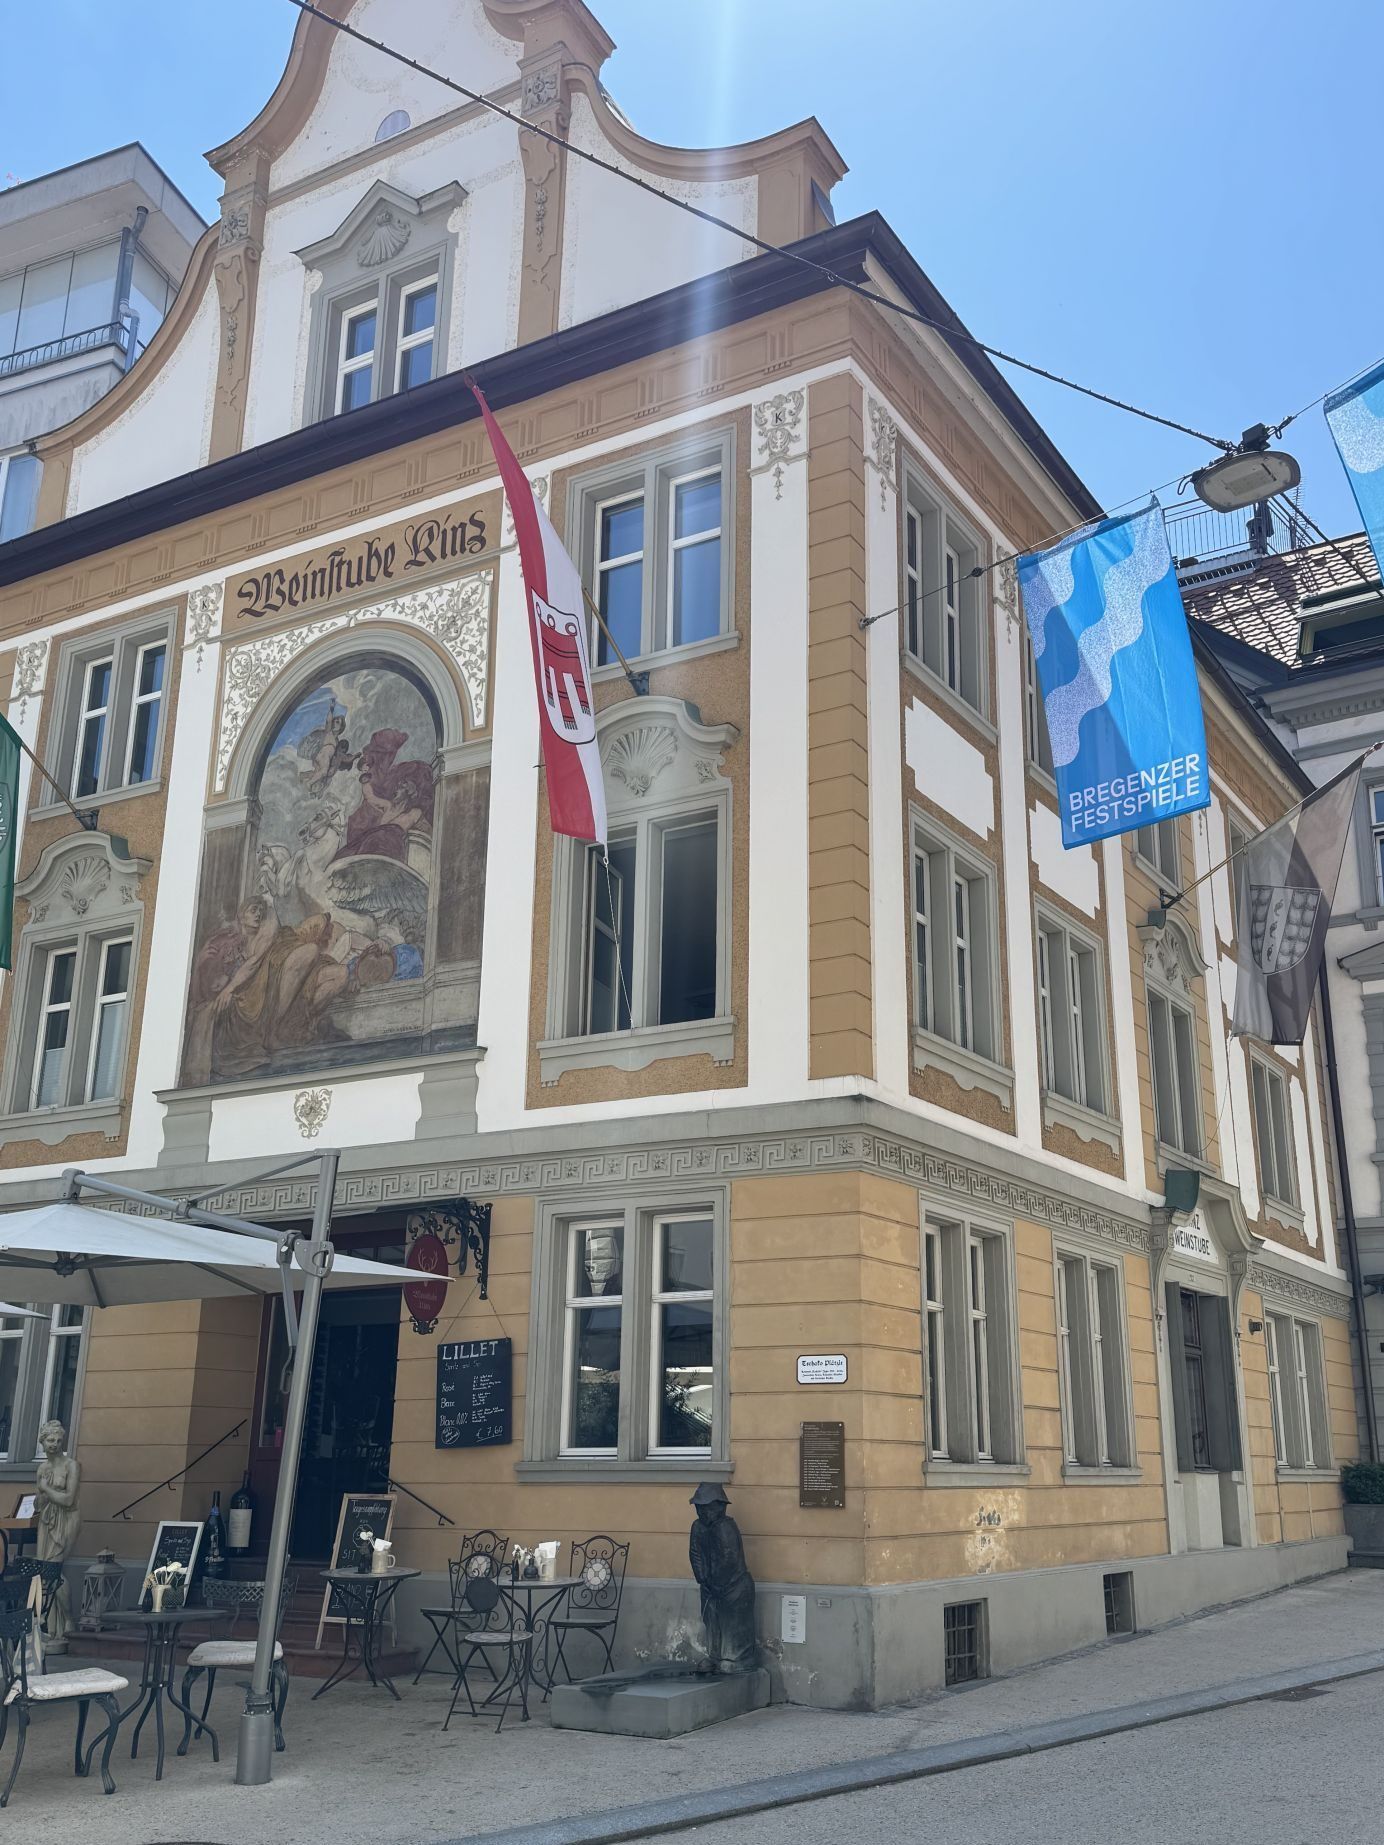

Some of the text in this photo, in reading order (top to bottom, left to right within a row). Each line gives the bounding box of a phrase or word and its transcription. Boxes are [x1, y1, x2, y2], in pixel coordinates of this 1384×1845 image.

[775, 412, 783, 424] K
[237, 510, 487, 619] Weinstube Kinz
[1069, 753, 1200, 811] BREGENZER
[1071, 775, 1200, 833] FESTSPIELE
[1174, 1229, 1211, 1255] WEINSTUBE
[442, 1341, 498, 1360] LILLET
